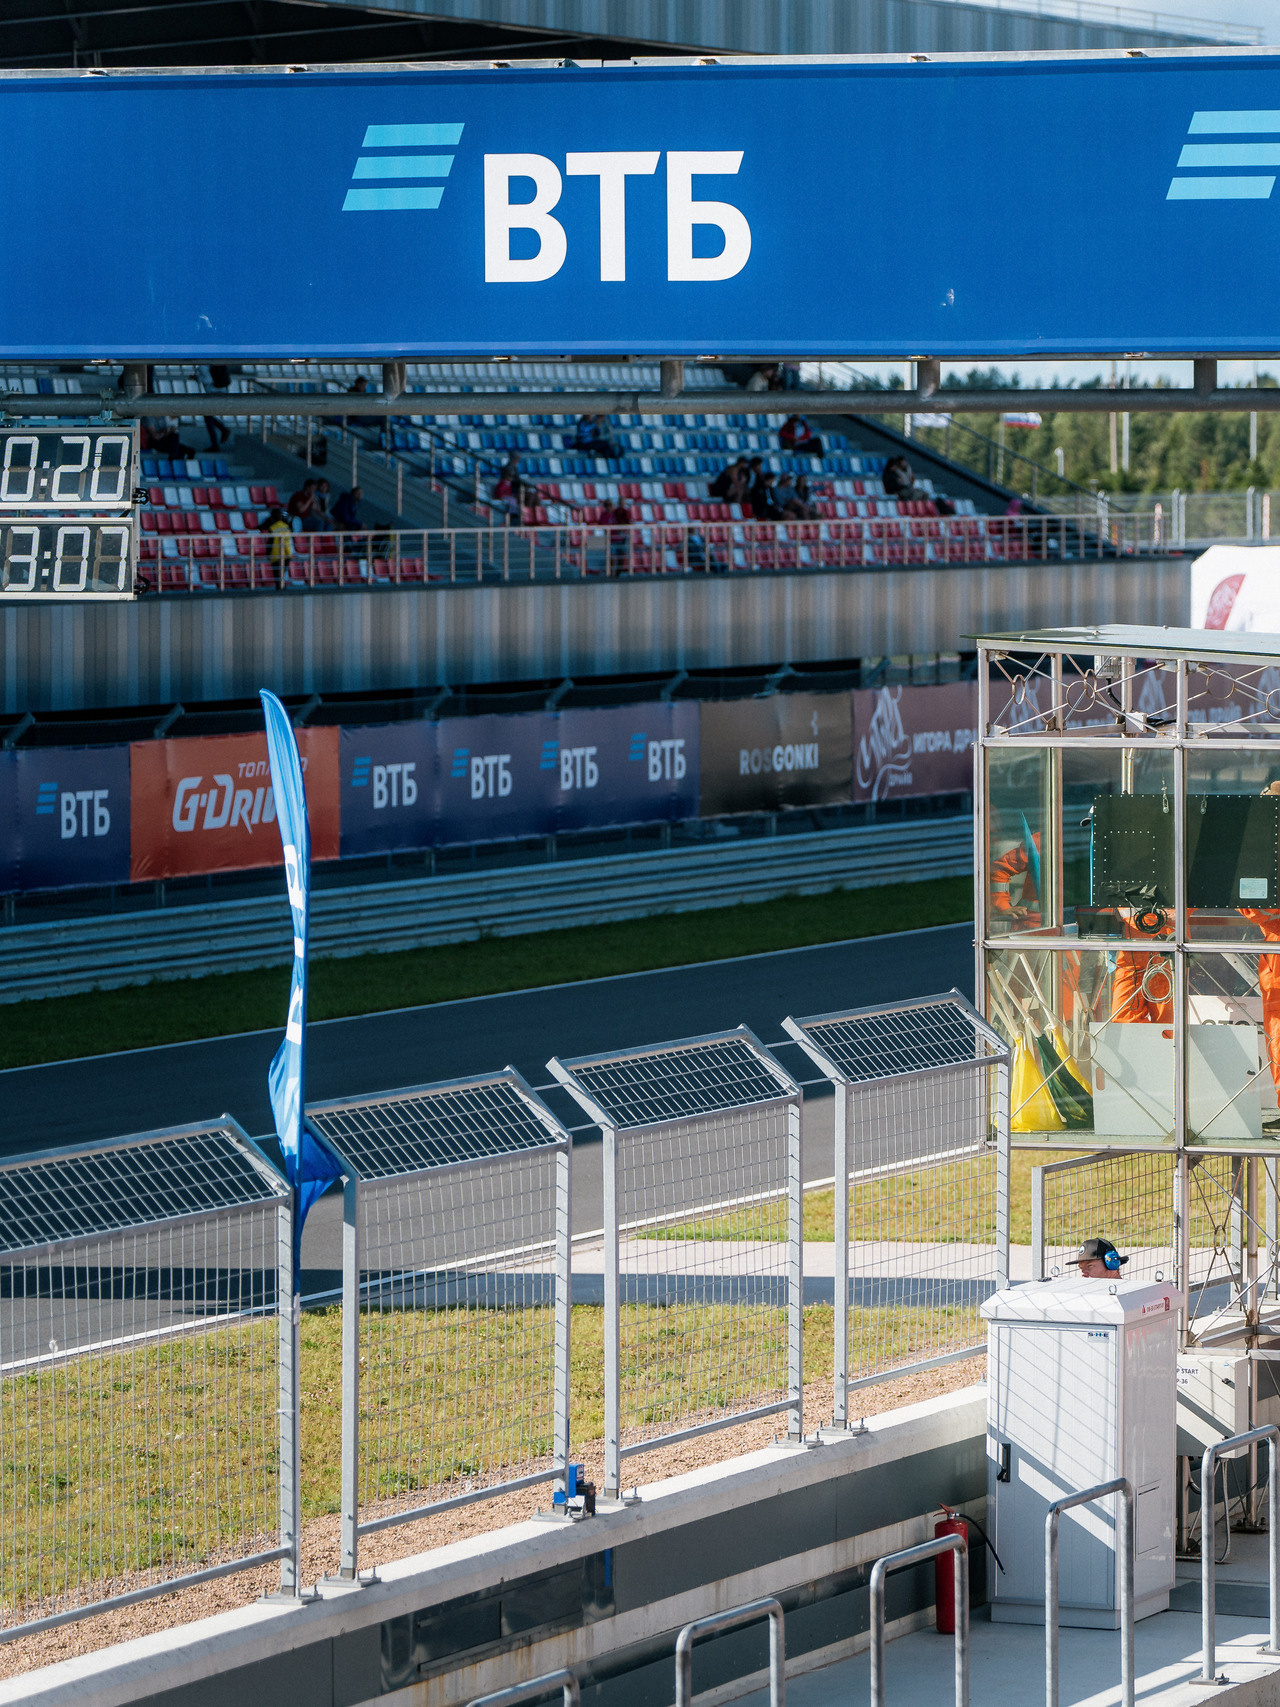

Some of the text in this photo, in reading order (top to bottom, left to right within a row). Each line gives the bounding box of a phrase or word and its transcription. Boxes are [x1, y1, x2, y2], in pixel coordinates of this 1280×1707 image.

[484, 150, 752, 283] ВТБ
[471, 754, 512, 799] ВТБ
[560, 746, 599, 790] ВТБ
[648, 739, 687, 782] ВТБ
[739, 743, 819, 775] ROSGONKI
[373, 762, 418, 809] ВТБ
[60, 789, 110, 839] ВТБ
